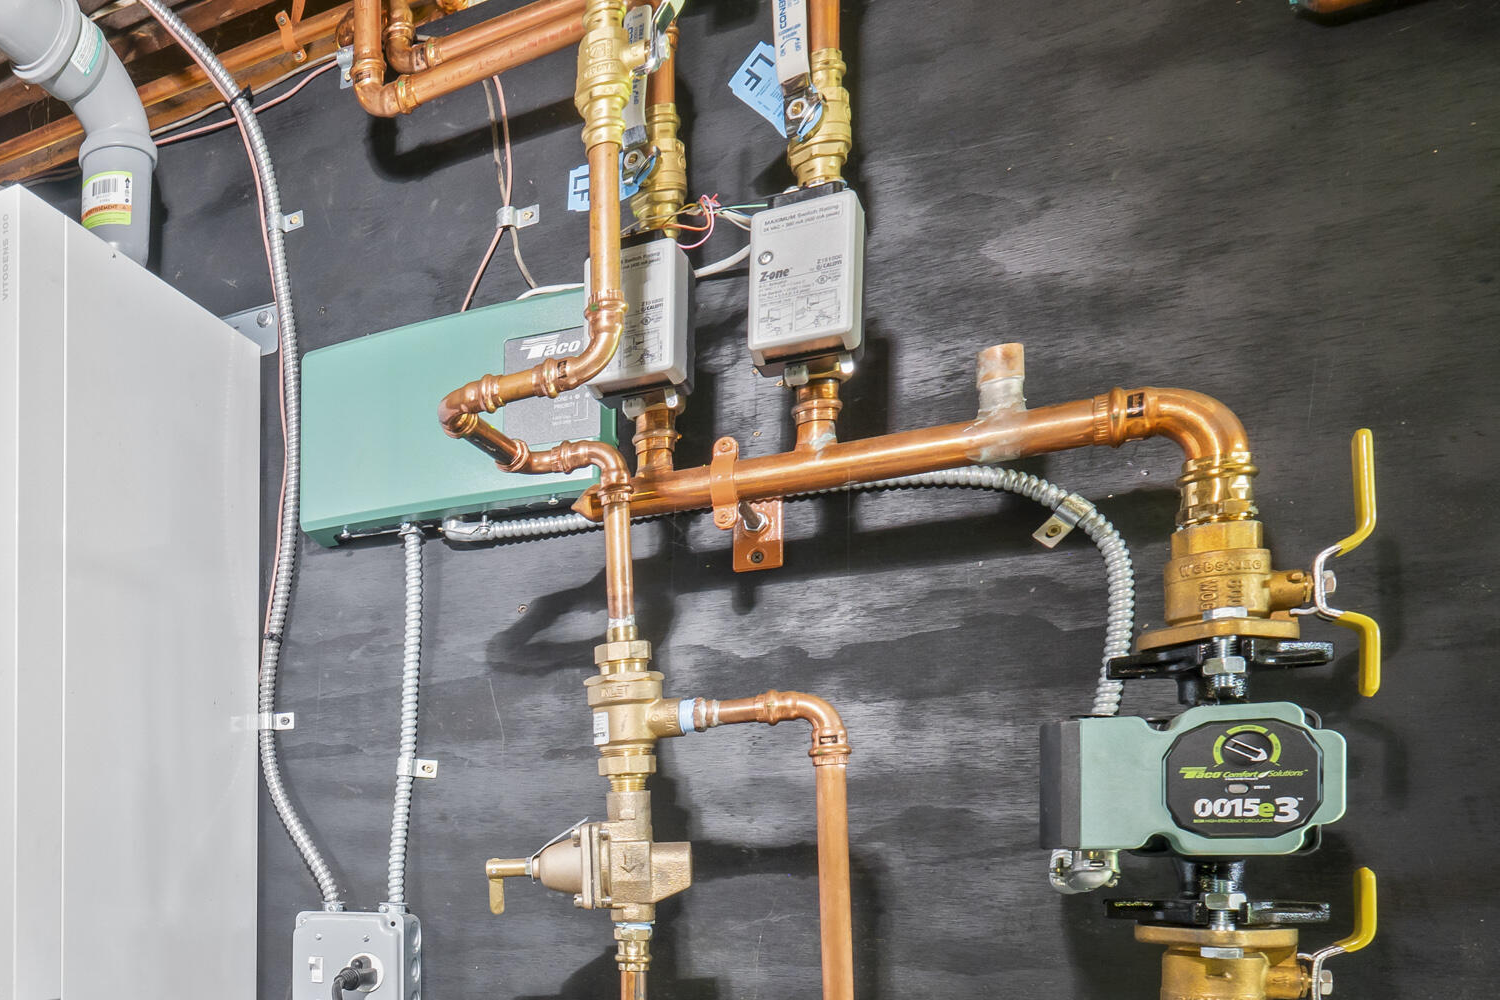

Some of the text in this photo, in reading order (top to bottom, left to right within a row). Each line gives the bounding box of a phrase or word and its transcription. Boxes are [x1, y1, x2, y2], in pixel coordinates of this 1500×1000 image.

[744, 53, 776, 92] LF
[2, 238, 10, 302] VITODENS
[759, 267, 790, 283] Z-one
[519, 334, 582, 360] Taco
[1179, 766, 1222, 779] Taco
[1222, 769, 1304, 779] Comfort Solutions
[1194, 796, 1300, 823] 0015e3
